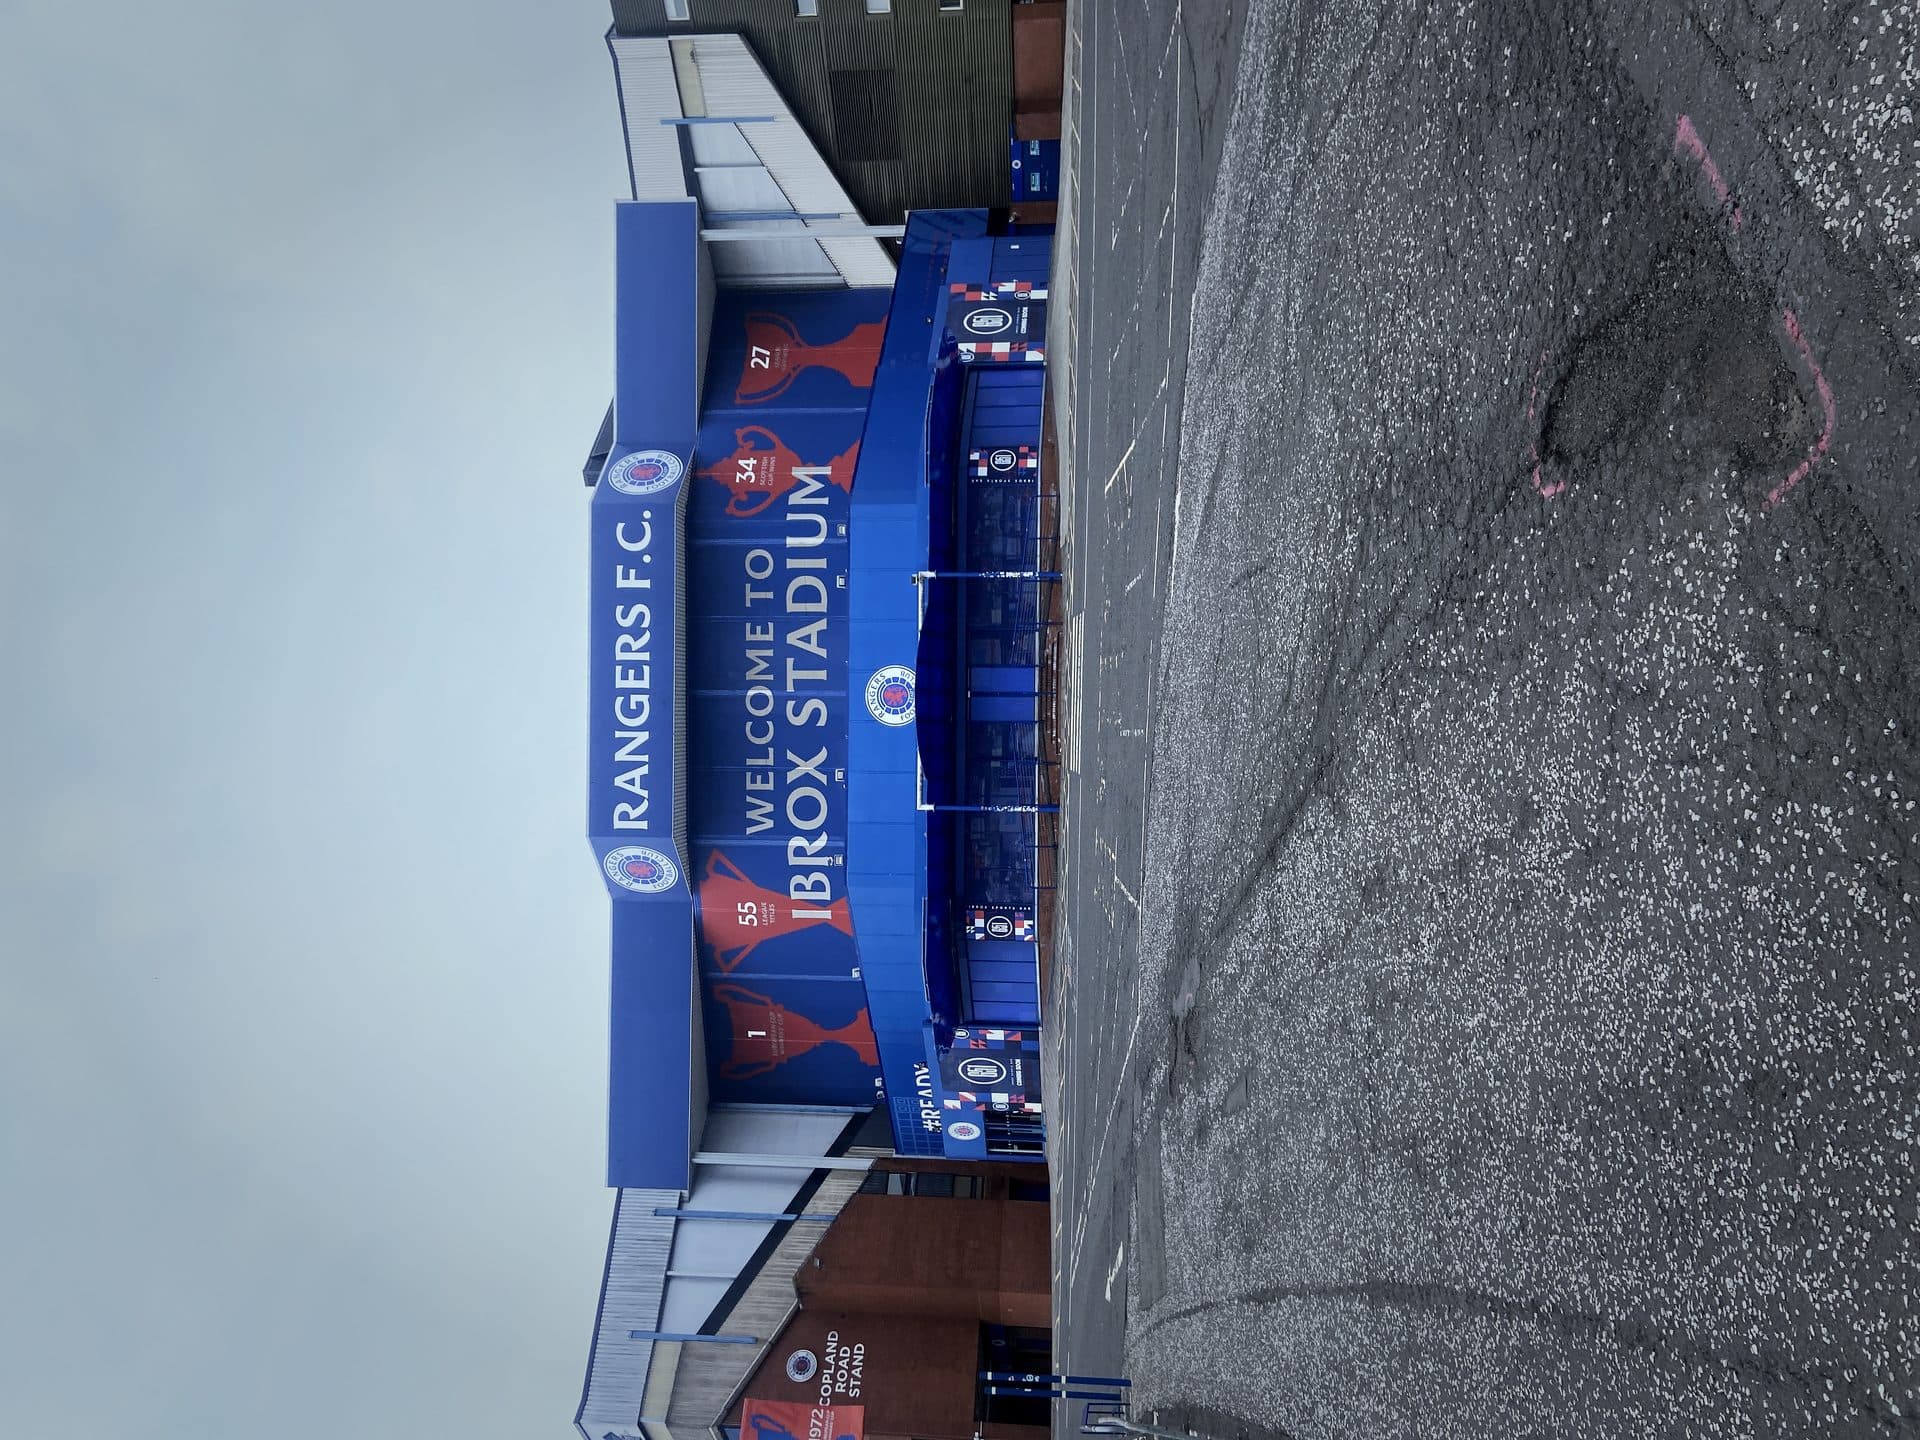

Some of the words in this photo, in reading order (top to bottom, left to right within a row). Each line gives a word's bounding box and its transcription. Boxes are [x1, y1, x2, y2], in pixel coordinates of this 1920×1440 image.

[750, 346, 770, 369] 27
[612, 456, 639, 488] RANGERS
[736, 458, 757, 484] 34
[616, 510, 652, 589] F.C.
[745, 548, 774, 607] TO
[786, 466, 832, 727] STADIUM
[613, 603, 650, 830] RANGERS
[869, 672, 886, 718] RANGERS
[745, 622, 774, 835] WELCOME
[786, 746, 832, 920] IBROX
[608, 852, 633, 887] RANGERS
[738, 902, 758, 926] 55
[768, 904, 776, 923] TITLES
[747, 1030, 766, 1038] 1
[819, 1330, 838, 1406] COPLAND
[835, 1346, 850, 1392] ROAD
[848, 1343, 864, 1398] STAND
